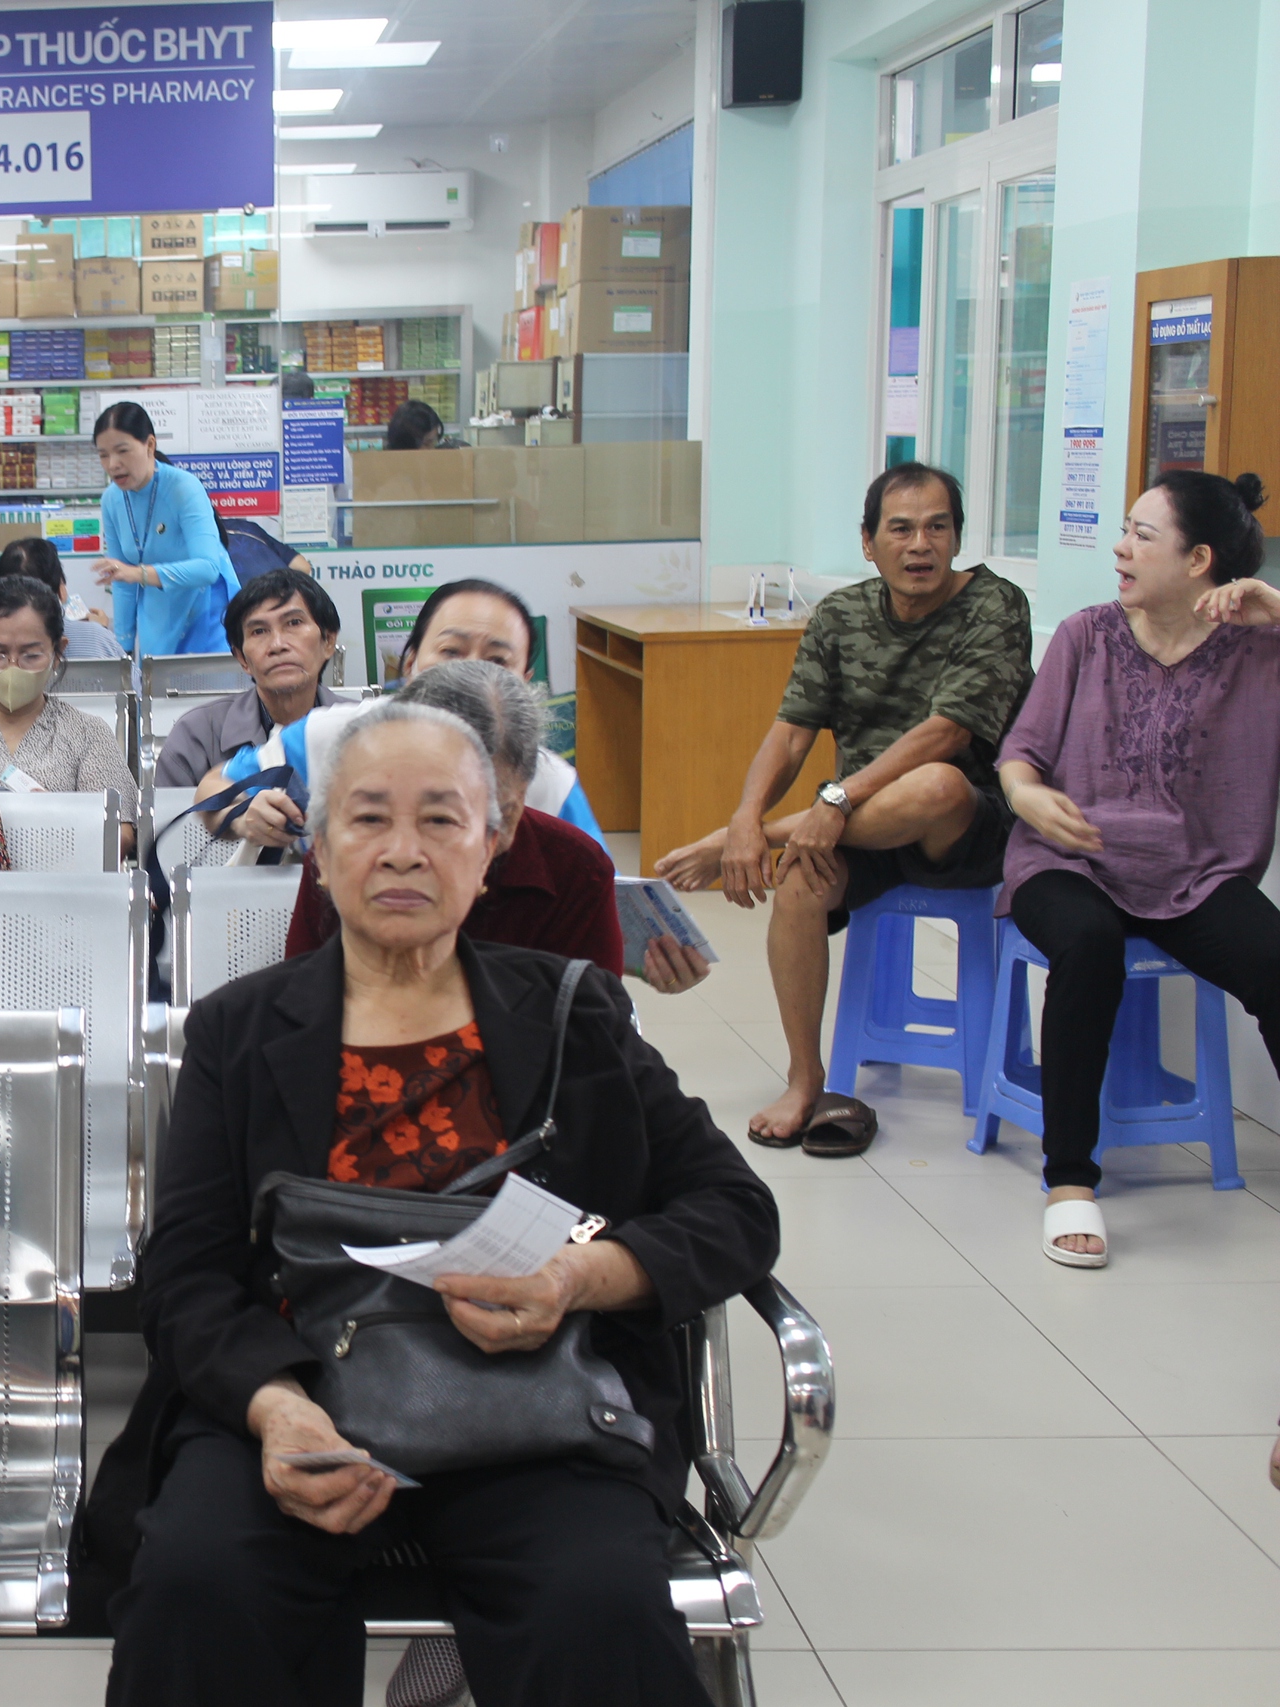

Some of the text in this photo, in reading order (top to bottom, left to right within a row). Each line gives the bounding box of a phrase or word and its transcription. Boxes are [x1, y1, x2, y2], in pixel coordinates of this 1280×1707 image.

[15, 17, 147, 66] THUỐC
[153, 25, 253, 62] BHYT
[112, 78, 255, 105] PHARMACY
[1070, 439, 1082, 448] 1900
[327, 561, 376, 580] THẢO
[382, 563, 434, 582] DƯỢC
